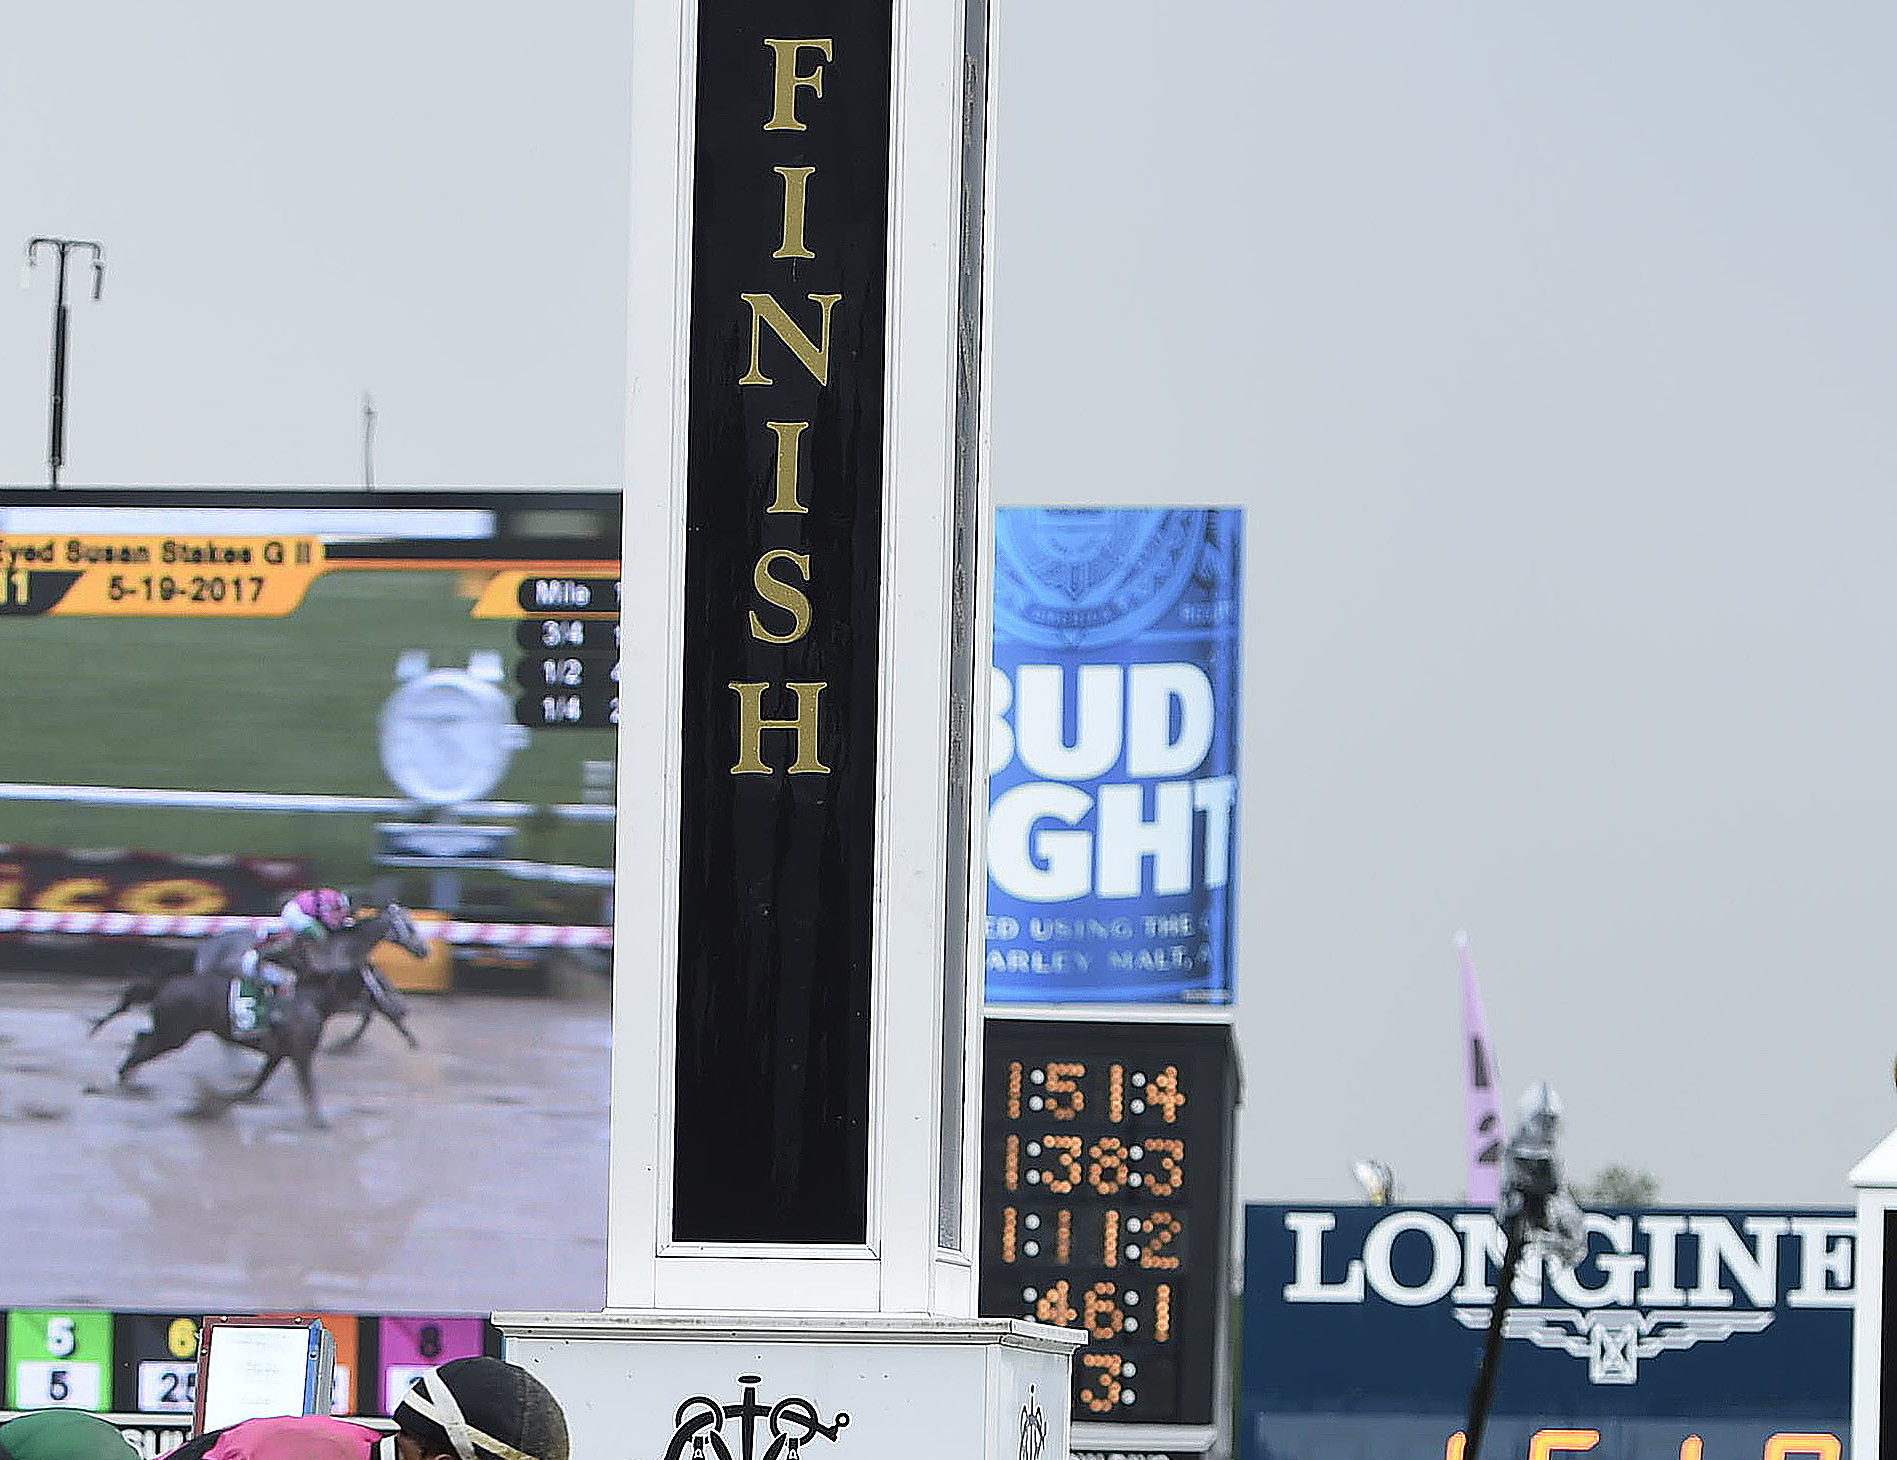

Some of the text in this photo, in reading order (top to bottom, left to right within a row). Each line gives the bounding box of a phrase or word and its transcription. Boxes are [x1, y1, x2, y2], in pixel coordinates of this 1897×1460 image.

[727, 37, 843, 775] FINISH
[263, 541, 283, 564] G
[108, 575, 265, 602] 5-19-2017
[1028, 915, 1135, 942] USING
[1142, 912, 1193, 938] THE
[46, 1316, 78, 1360] 5
[48, 1368, 70, 1402] 5
